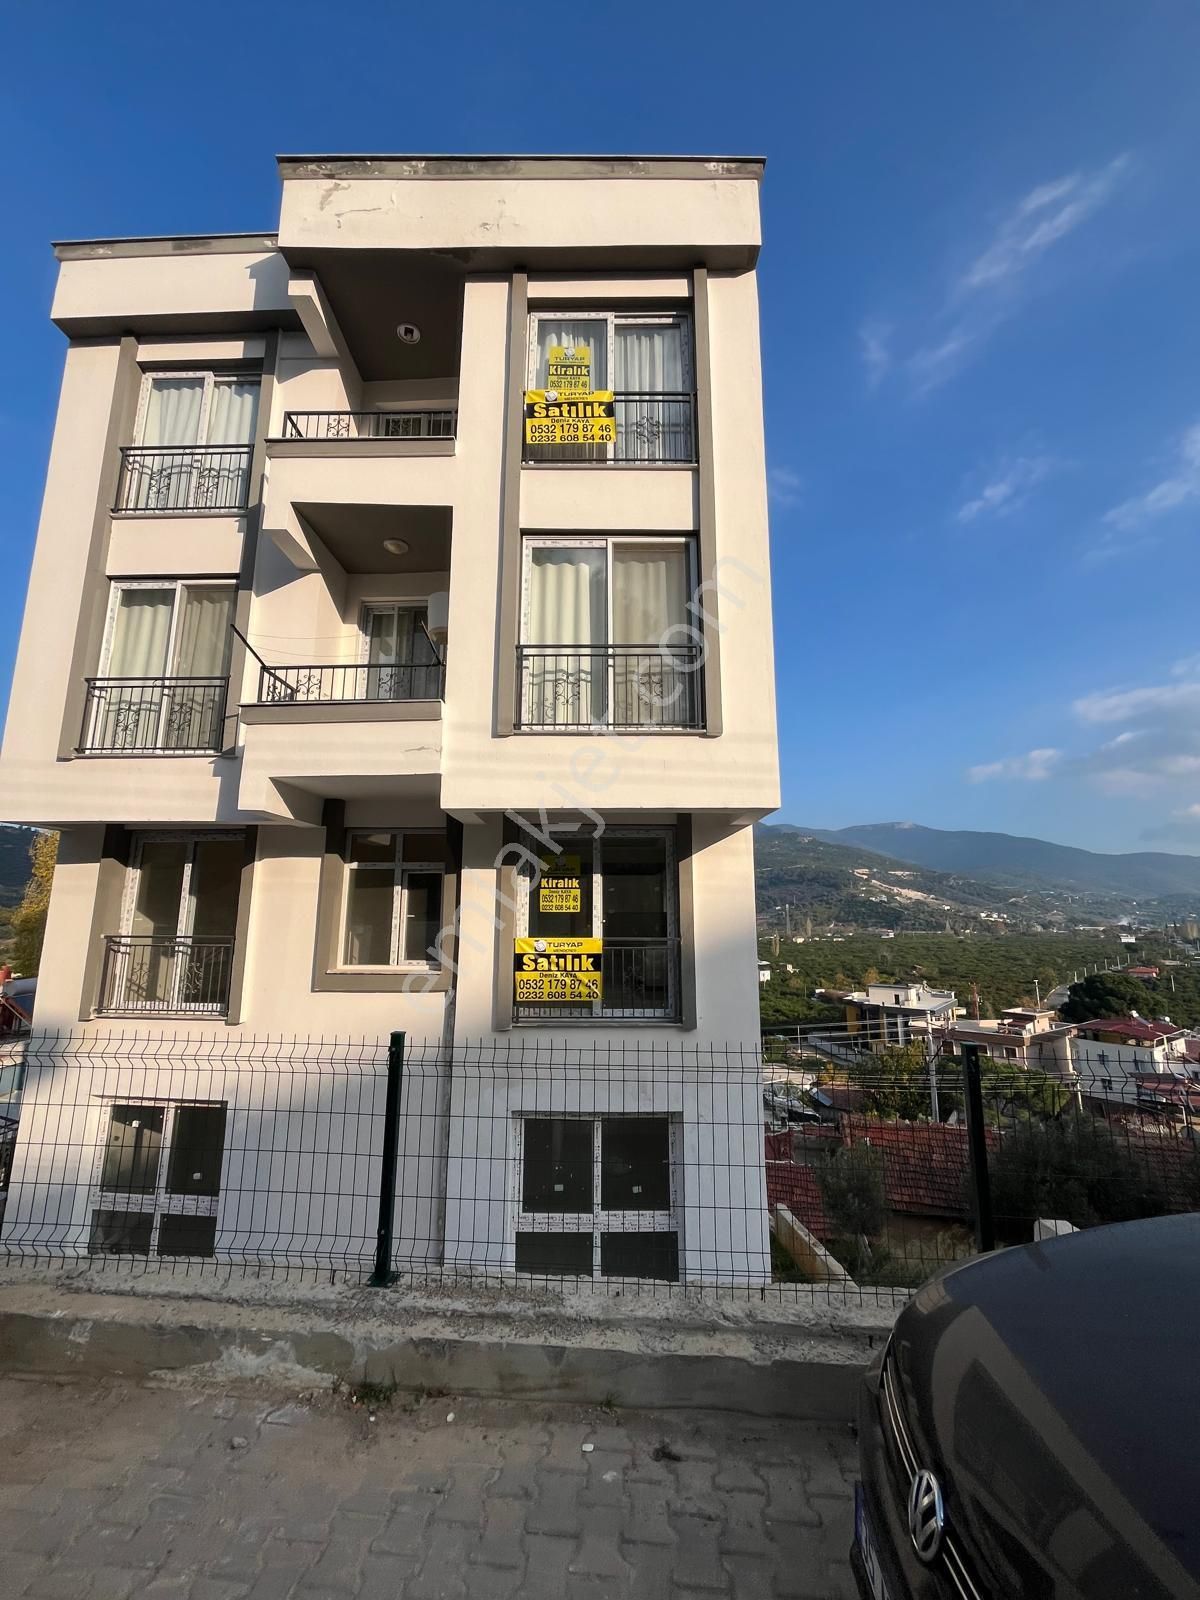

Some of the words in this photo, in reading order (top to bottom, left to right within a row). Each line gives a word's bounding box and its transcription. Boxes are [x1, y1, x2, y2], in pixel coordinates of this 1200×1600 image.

[549, 365, 590, 376] Kiralık
[533, 402, 607, 418] Satılık
[530, 424, 557, 434] 0532
[559, 423, 579, 434] 179
[582, 423, 595, 433] 87
[598, 424, 612, 433] 46
[530, 434, 557, 442] 0232
[559, 434, 579, 442] 608
[540, 877, 580, 888] Kiralık
[555, 894, 564, 903] 179
[564, 894, 571, 903] 87
[522, 954, 595, 971] Satılık
[518, 979, 545, 990] 0532
[547, 979, 567, 990] 179
[569, 979, 582, 989] 87
[585, 979, 599, 990] 46
[518, 991, 545, 1000] 0232
[547, 991, 567, 999] 608
[569, 991, 583, 999] 54
[585, 991, 599, 999] 40
